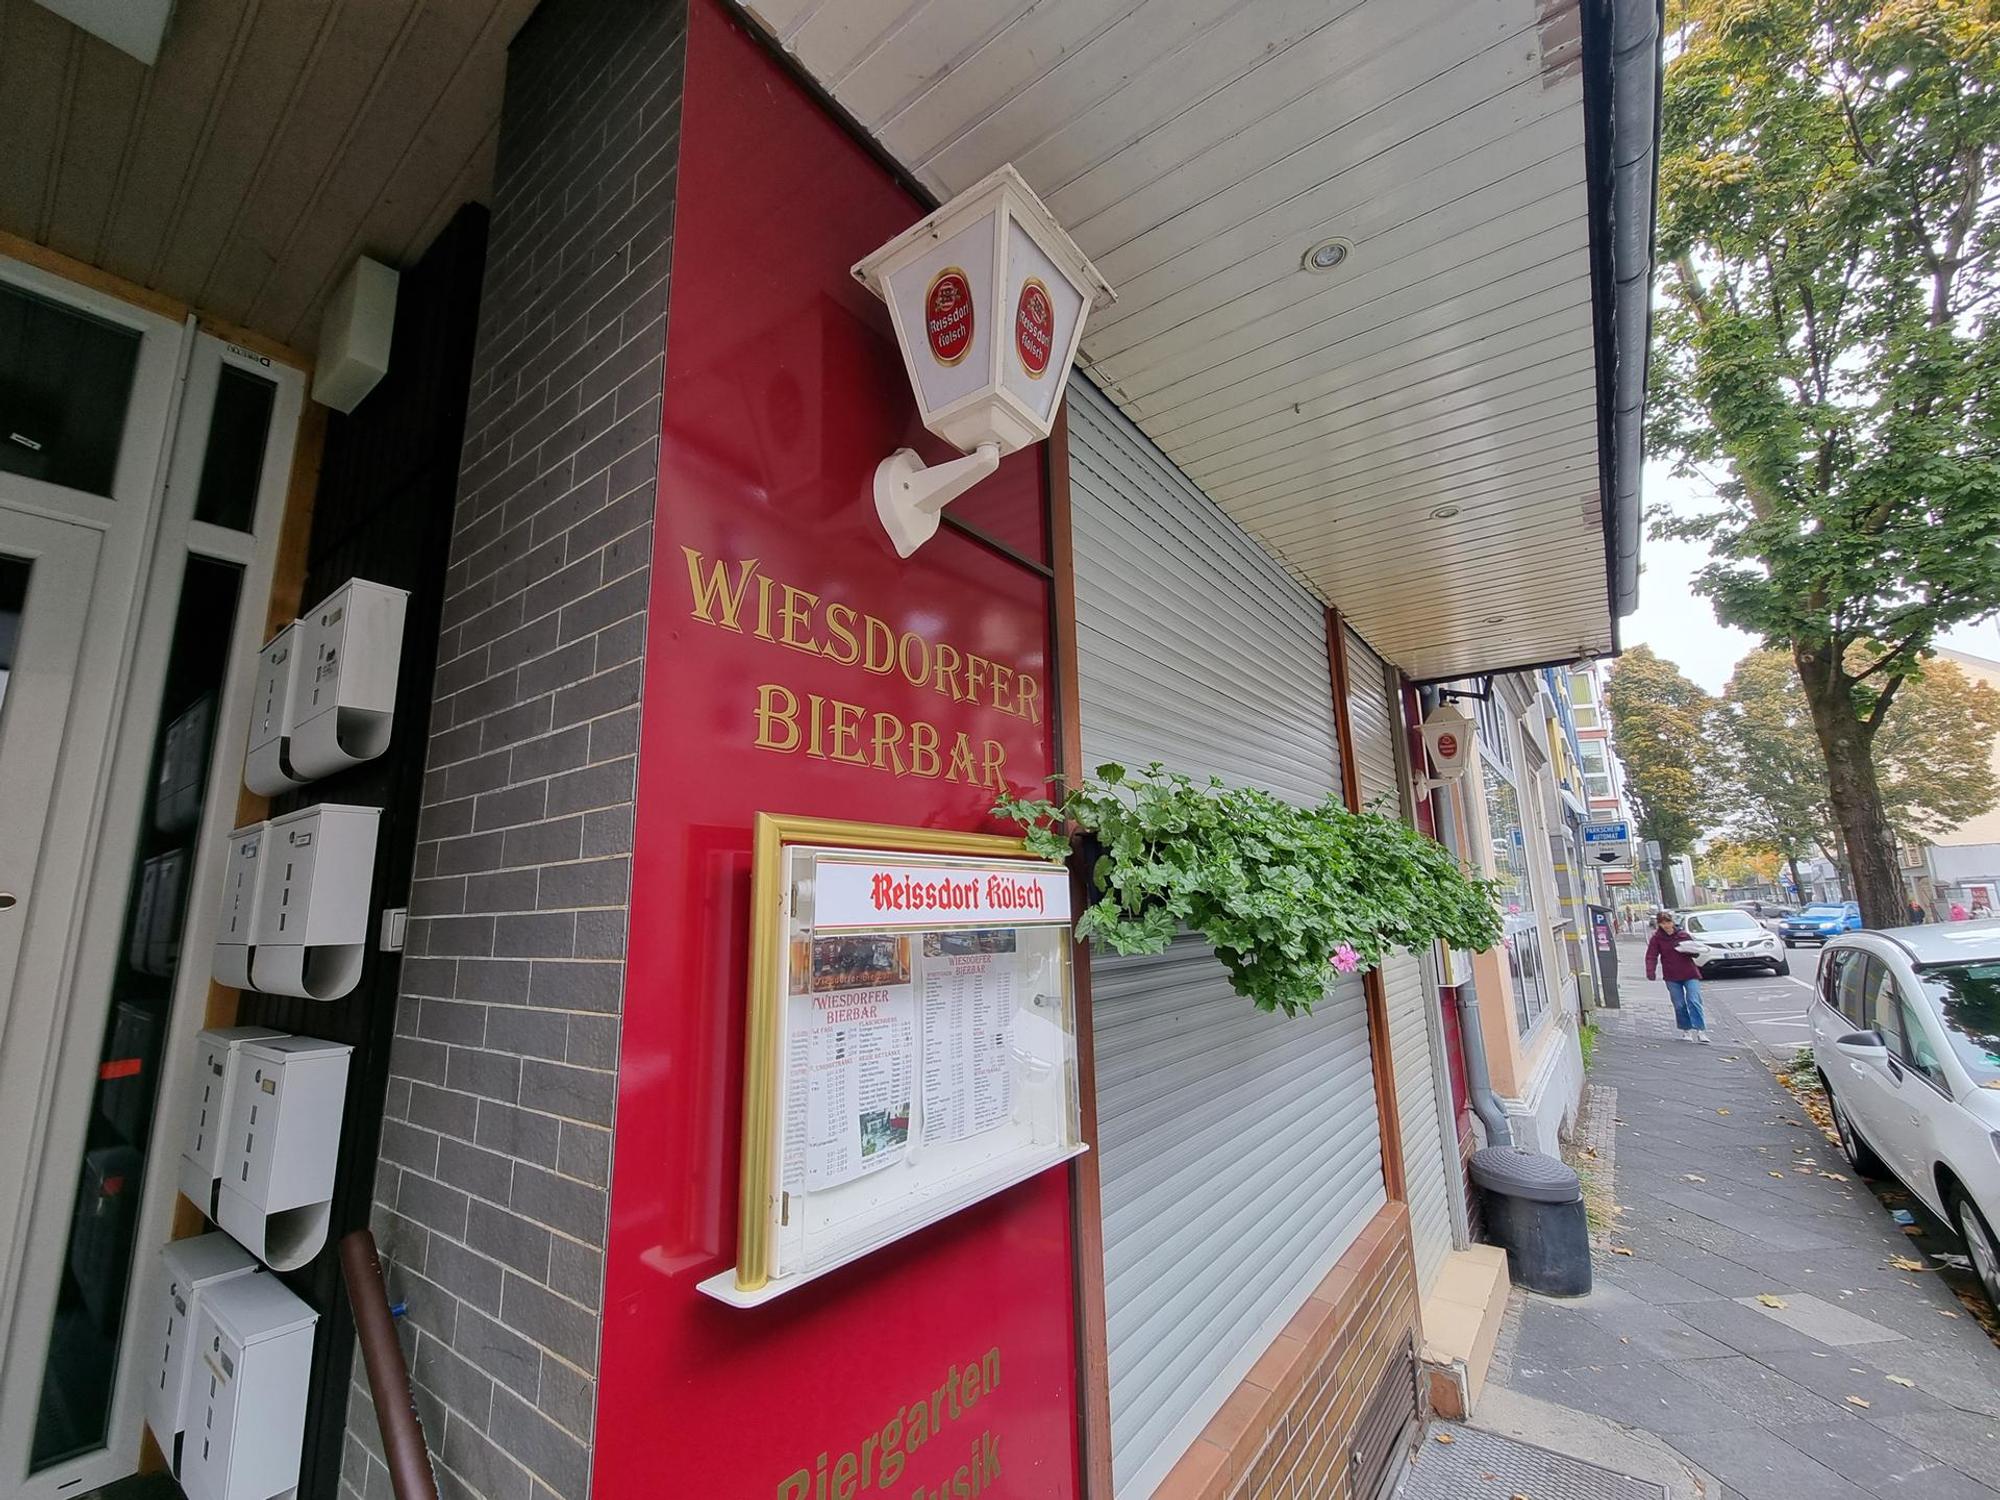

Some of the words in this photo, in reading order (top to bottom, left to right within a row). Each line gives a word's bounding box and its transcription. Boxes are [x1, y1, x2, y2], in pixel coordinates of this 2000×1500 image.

[680, 545, 1042, 727] WIESDORFER
[753, 683, 1010, 793] BIERBAR
[871, 872, 980, 911] Reissdorf
[985, 874, 1044, 915] Kölsch
[1596, 914, 1604, 924] P
[812, 989, 889, 1010] WIESDORFER
[826, 1006, 878, 1024] BIERBAR
